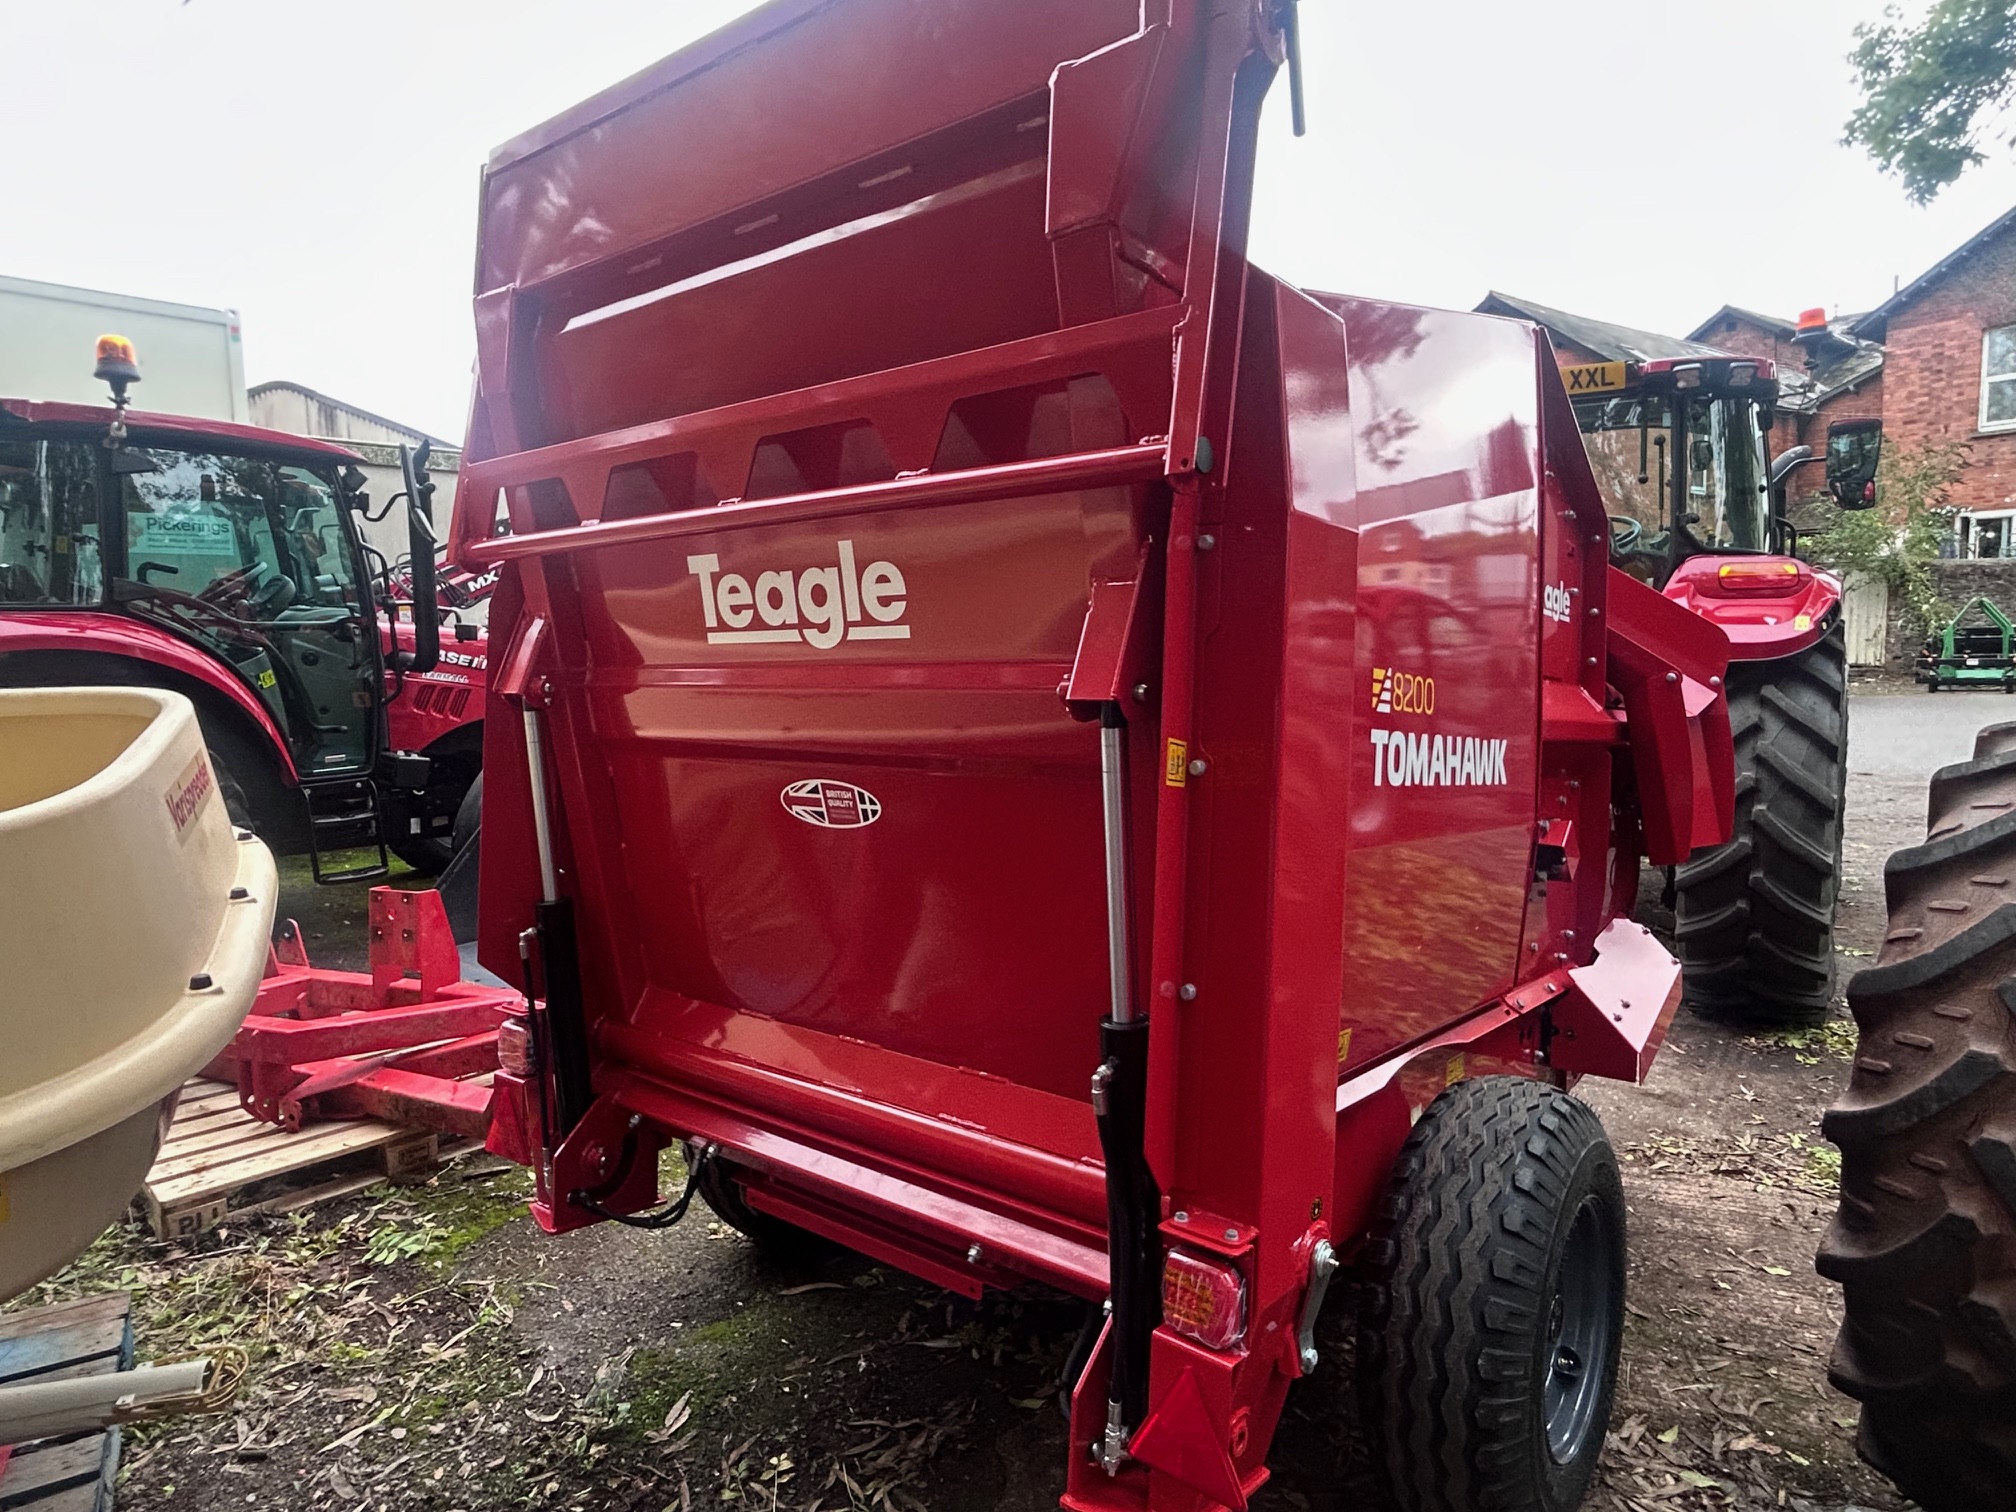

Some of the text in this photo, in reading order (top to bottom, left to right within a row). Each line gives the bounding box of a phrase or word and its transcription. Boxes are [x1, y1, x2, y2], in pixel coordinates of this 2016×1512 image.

[1570, 367, 1615, 389] XXL
[146, 517, 230, 535] Pickerings
[687, 540, 908, 649] Teagle
[1544, 580, 1570, 622] agle
[1393, 672, 1435, 715] 8200
[1371, 728, 1508, 787] TOMAHAWK
[826, 789, 852, 799] BRITISH
[827, 799, 853, 808] QUALITY
